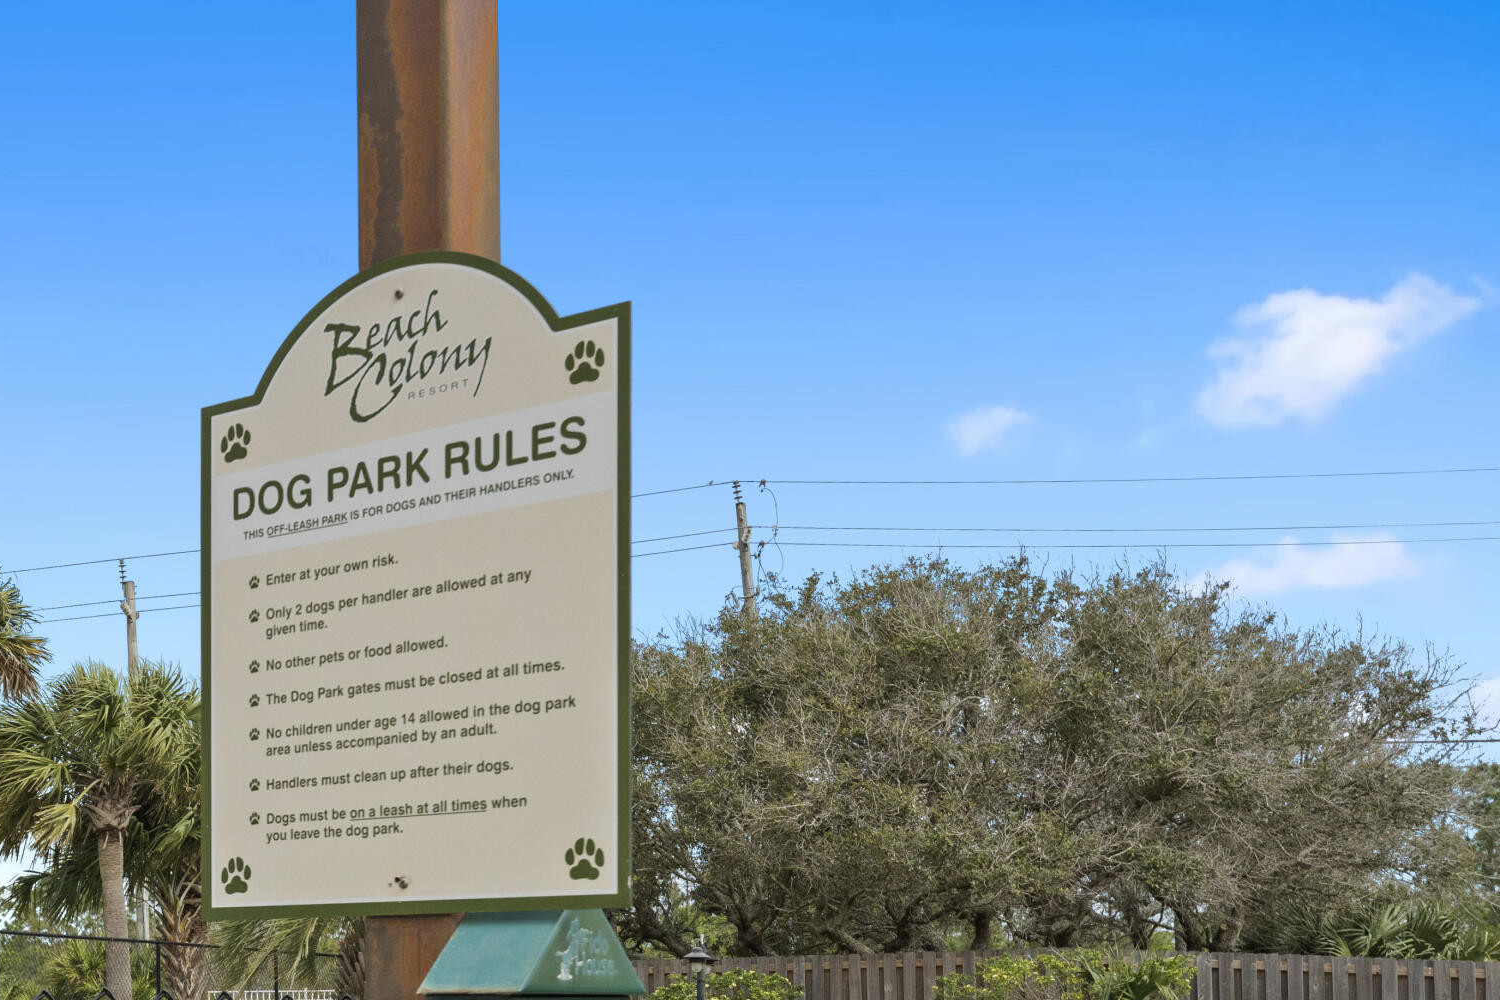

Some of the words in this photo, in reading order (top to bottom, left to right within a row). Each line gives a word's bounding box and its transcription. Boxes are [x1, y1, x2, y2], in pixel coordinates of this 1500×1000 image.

[324, 290, 448, 396] Beach
[350, 336, 492, 422] Colony
[408, 379, 468, 400] RESORT
[233, 474, 312, 520] DOG
[327, 448, 430, 502] PARK
[445, 416, 587, 479] RULES
[243, 527, 264, 540] THIS
[267, 518, 319, 538] OFF-LEASH
[322, 512, 347, 528] PARK
[350, 509, 359, 520] IS
[363, 504, 383, 517] FOR
[386, 498, 416, 513] DOGS
[419, 493, 441, 507] AND
[444, 487, 476, 502] THEIR
[480, 475, 540, 495] HANDLERS
[543, 468, 574, 483] ONLY.
[266, 572, 296, 586] Enter
[300, 567, 310, 580] at
[314, 565, 340, 581] your
[344, 559, 368, 572] own
[372, 552, 398, 568] risk.
[266, 605, 292, 620] Only
[296, 603, 302, 615] 2
[306, 600, 335, 614] dogs
[338, 596, 358, 611] per
[362, 589, 409, 605] handler
[412, 585, 432, 597] are
[436, 574, 486, 594] allowed
[490, 571, 503, 585] at
[507, 569, 531, 583] any
[266, 624, 296, 640] given
[299, 619, 328, 632] time.
[266, 658, 282, 671] No
[285, 655, 316, 668] other
[319, 651, 344, 667] pets
[348, 649, 361, 660] or
[364, 642, 392, 658] food
[396, 636, 448, 654] allowed.
[266, 692, 287, 704] The
[291, 690, 314, 703] Dog
[318, 684, 343, 699] Park
[347, 682, 381, 698] gates
[385, 676, 416, 691] must
[420, 674, 435, 687] be
[439, 668, 482, 684] closed
[486, 666, 499, 679] at
[503, 663, 518, 677] all
[523, 660, 564, 674] times.
[266, 727, 282, 739] No
[285, 722, 332, 737] children
[336, 717, 371, 732] under
[374, 716, 397, 730] age
[401, 712, 415, 724] 14
[419, 707, 468, 723] allowed
[473, 704, 485, 717] in
[489, 702, 510, 716] the
[514, 699, 540, 714] dog
[545, 696, 576, 713] park
[266, 744, 290, 756] area
[294, 740, 332, 753] unless
[336, 730, 417, 750] accompanied
[422, 728, 437, 743] by
[441, 728, 456, 739] an
[460, 722, 497, 737] adult.
[266, 776, 318, 790] Handlers
[321, 772, 350, 786] must
[354, 770, 386, 783] clean
[390, 769, 406, 782] up
[410, 765, 439, 779] after
[443, 761, 473, 775] their
[476, 759, 513, 774] dogs.
[267, 812, 296, 826] Dogs
[299, 809, 328, 822] must
[332, 808, 346, 820] be
[349, 808, 365, 820] on
[368, 808, 377, 819] a
[380, 803, 412, 818] leash
[416, 802, 429, 816] at
[432, 799, 447, 814] all
[451, 799, 487, 814] times
[491, 795, 527, 808] when
[266, 829, 287, 844] you
[291, 828, 320, 840] leave
[324, 825, 342, 838] the
[346, 824, 369, 838] dog
[373, 821, 403, 837] park.
